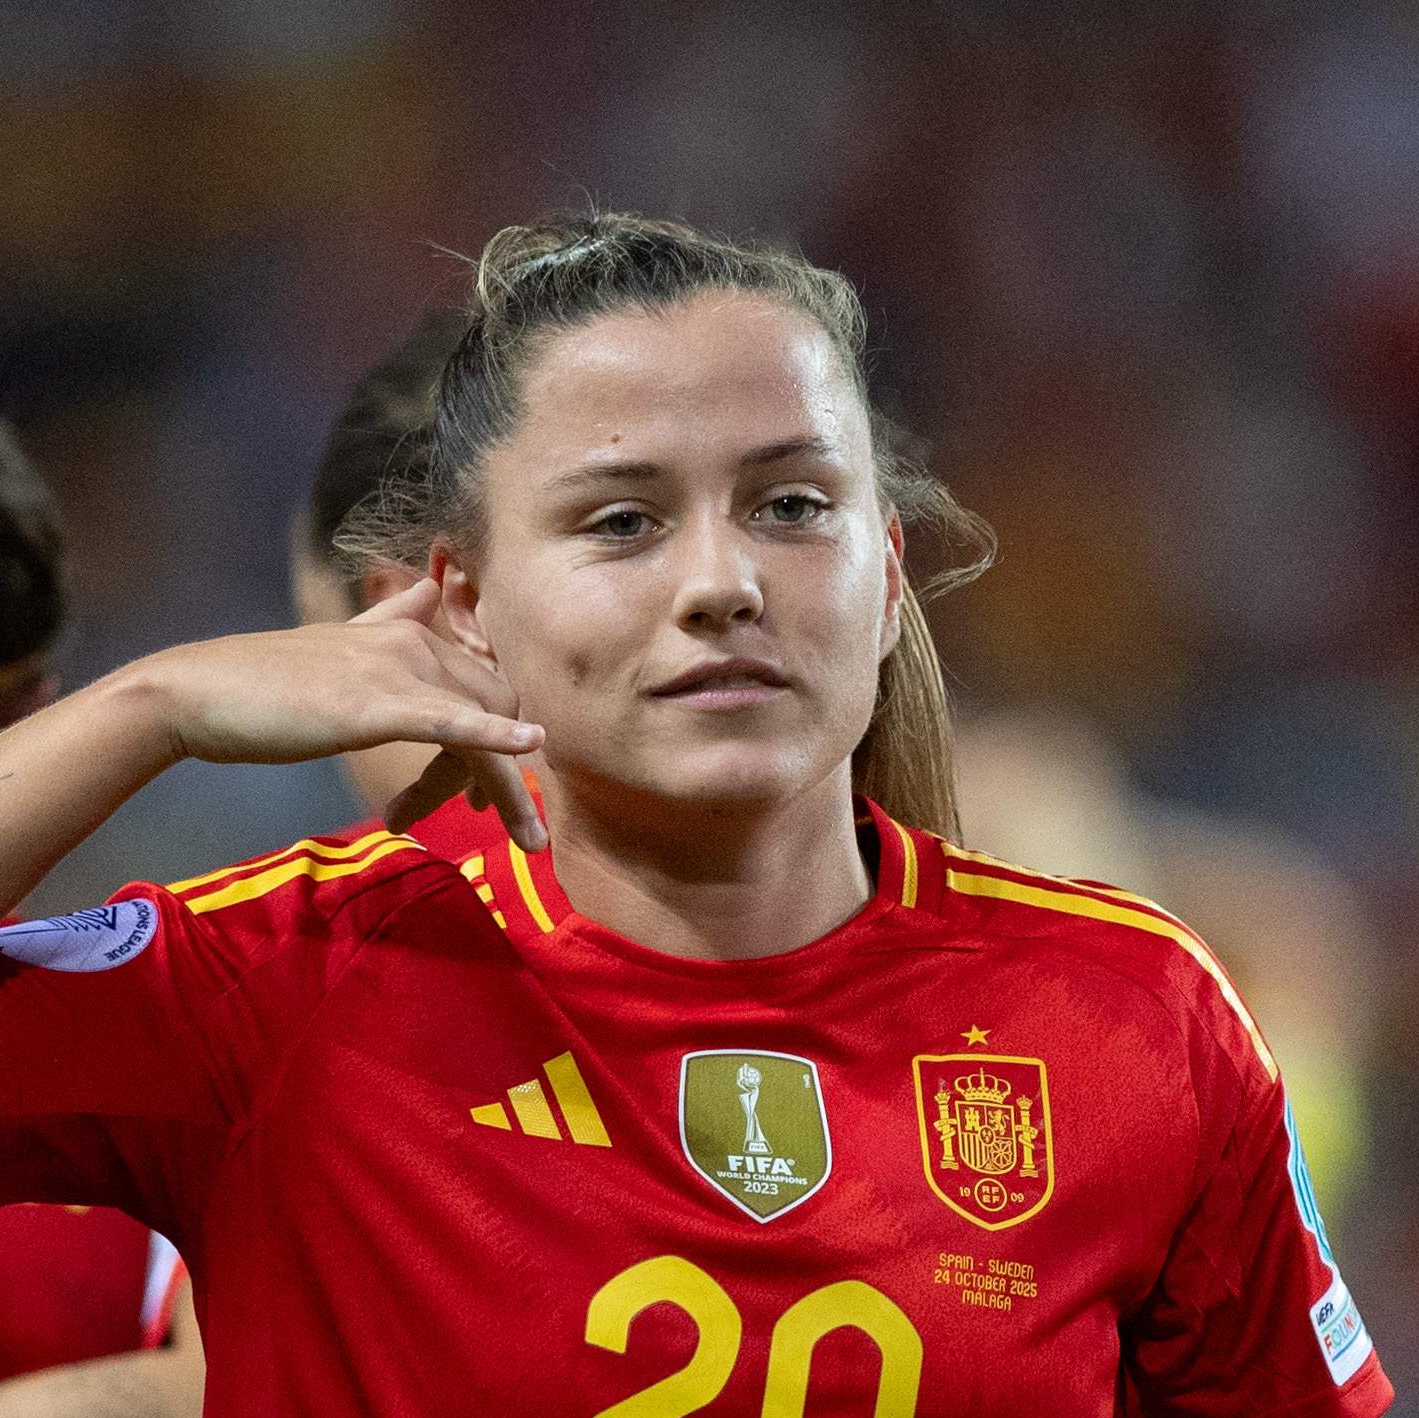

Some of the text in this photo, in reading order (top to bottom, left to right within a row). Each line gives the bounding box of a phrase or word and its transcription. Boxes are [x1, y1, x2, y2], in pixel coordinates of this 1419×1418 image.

[103, 930, 146, 962] LEAGUE
[716, 1171, 808, 1186] WORLD CHAMPIONS
[743, 1181, 779, 1195] 2023
[939, 1253, 974, 1271] SPAIN
[988, 1259, 1035, 1281] SWEDEN
[934, 1269, 1038, 1298] 24 OCTOBER 2025
[1316, 1302, 1336, 1326] UEFA
